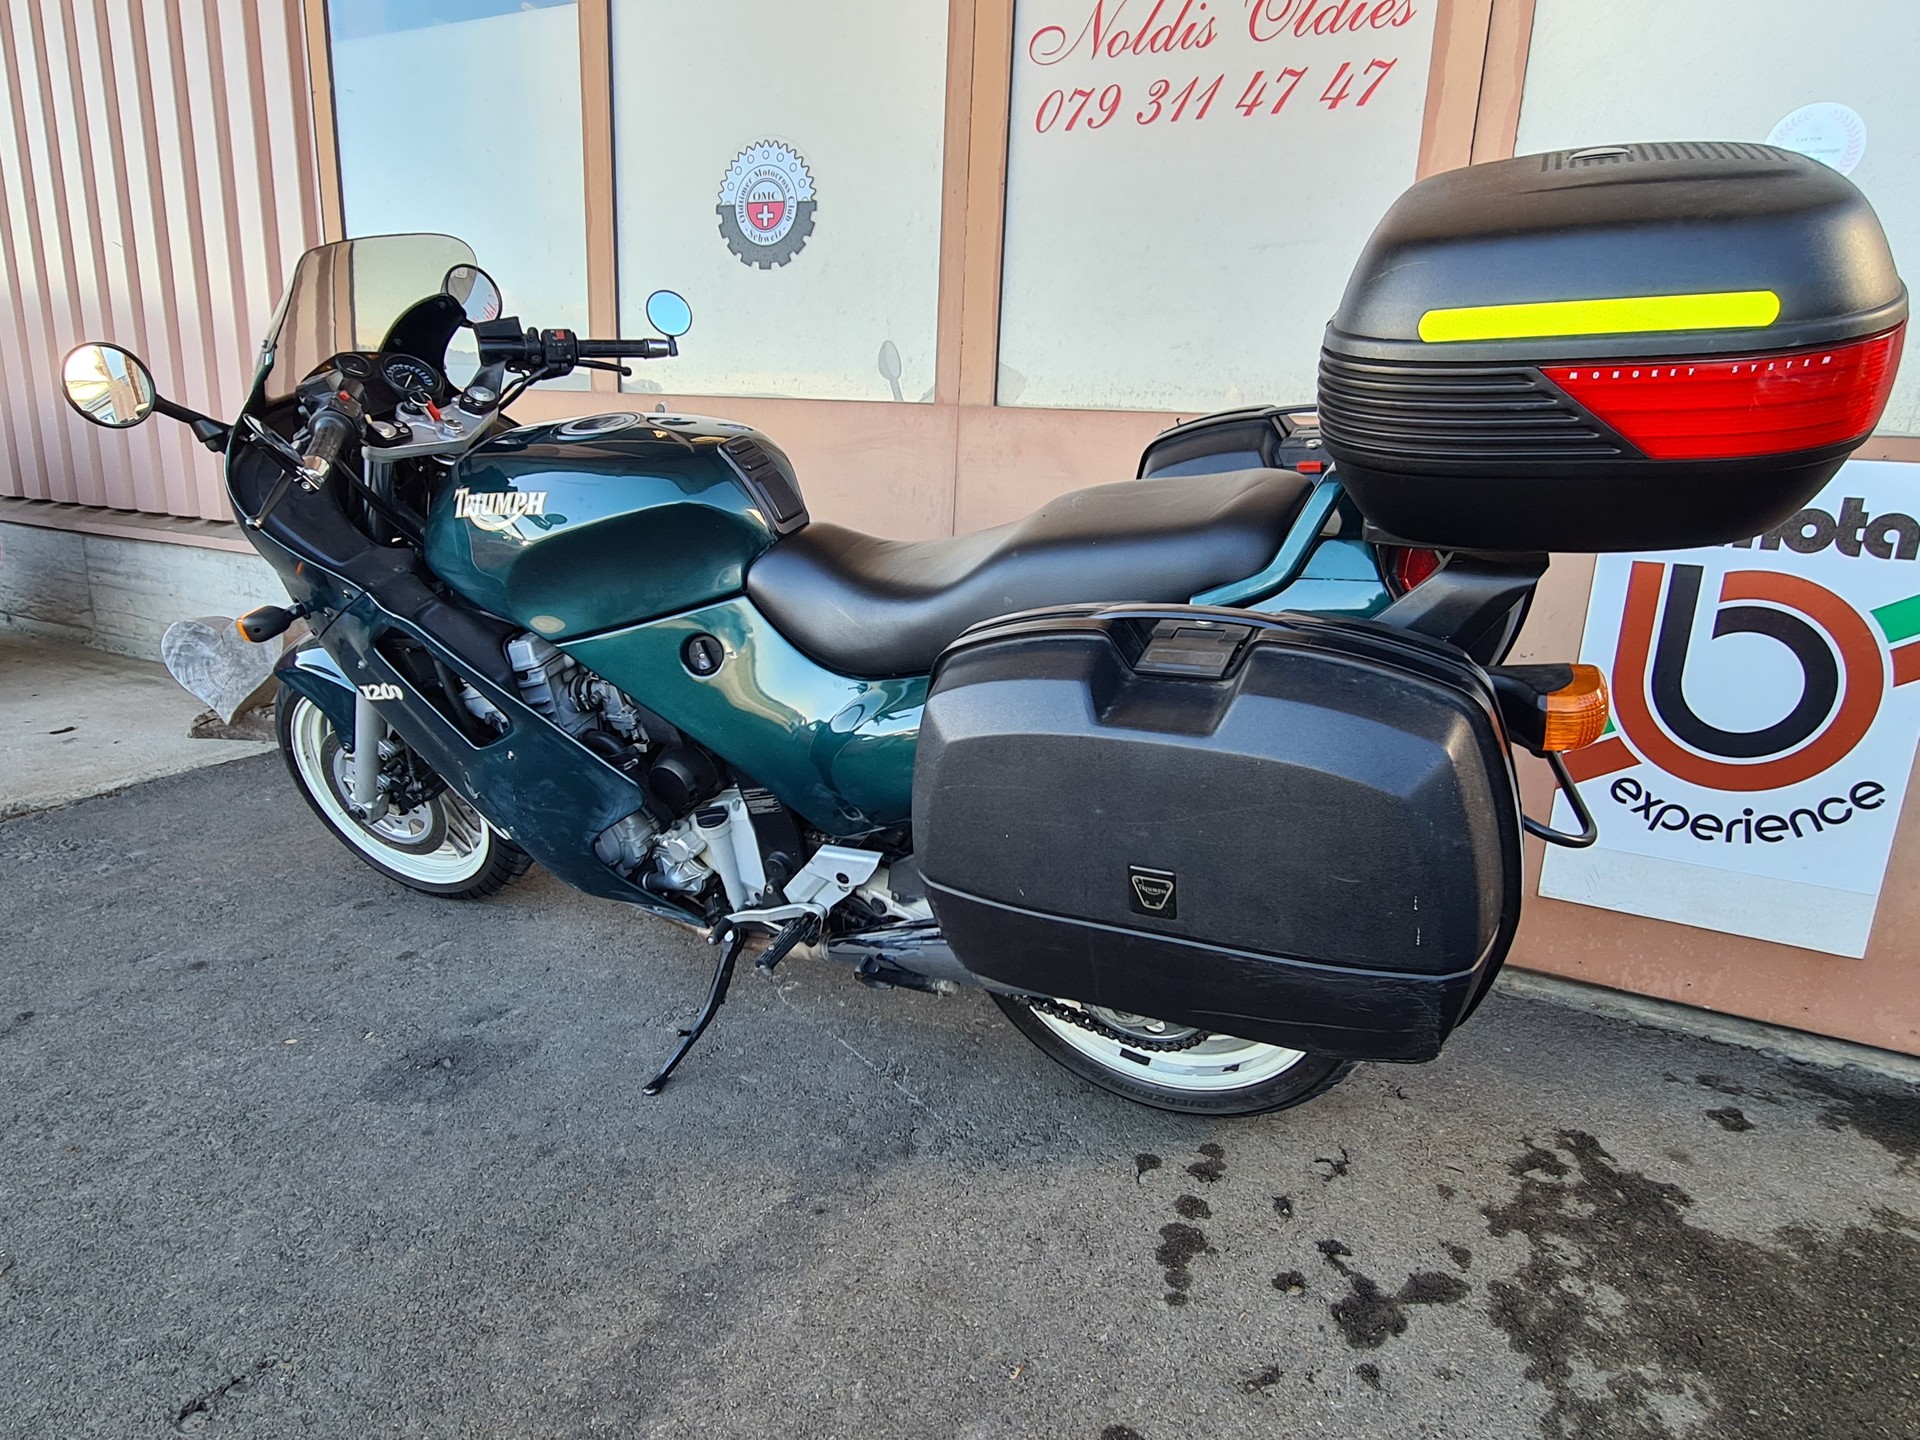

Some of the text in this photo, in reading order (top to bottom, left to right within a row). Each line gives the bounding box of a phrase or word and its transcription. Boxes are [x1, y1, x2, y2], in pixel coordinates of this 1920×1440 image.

[1029, 0, 1217, 66] Noldis
[1034, 56, 1398, 133] 079 311 47 47
[737, 169, 796, 223] Oldtimer Motocross Club
[753, 191, 780, 201] OMC
[1568, 355, 1832, 380] MONOKEY SYSTEM
[453, 485, 548, 527] TRIUMPH
[358, 682, 404, 701] 1200
[1610, 776, 1886, 844] experience
